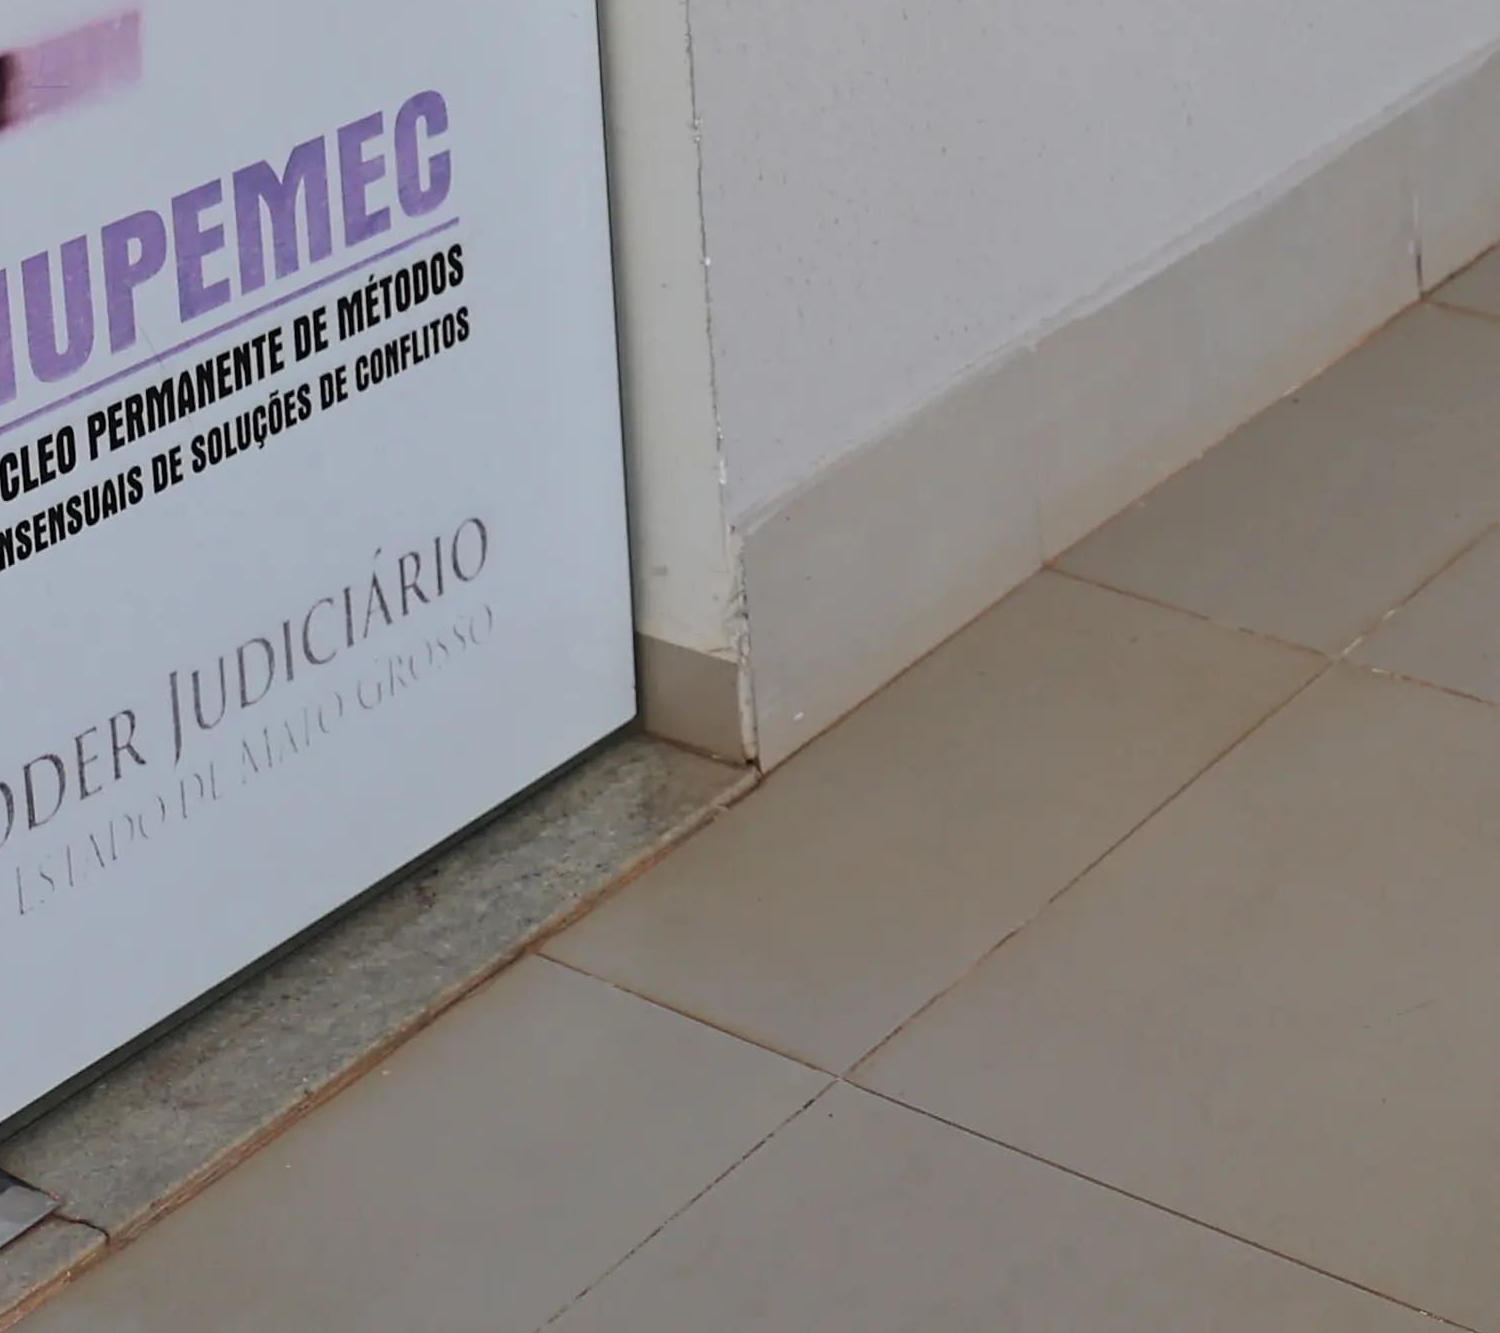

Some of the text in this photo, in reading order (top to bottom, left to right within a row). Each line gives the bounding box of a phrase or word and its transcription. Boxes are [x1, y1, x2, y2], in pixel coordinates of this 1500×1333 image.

[86, 333, 286, 462] PERMANENTE
[292, 306, 329, 363] DE
[336, 243, 466, 342] MÉTODOS
[152, 446, 184, 494] DE
[190, 383, 314, 475] SOLUÇÕES
[319, 366, 350, 413] DE
[354, 306, 472, 393] CONFLITOS
[168, 516, 491, 767] JUDICIÁRIO
